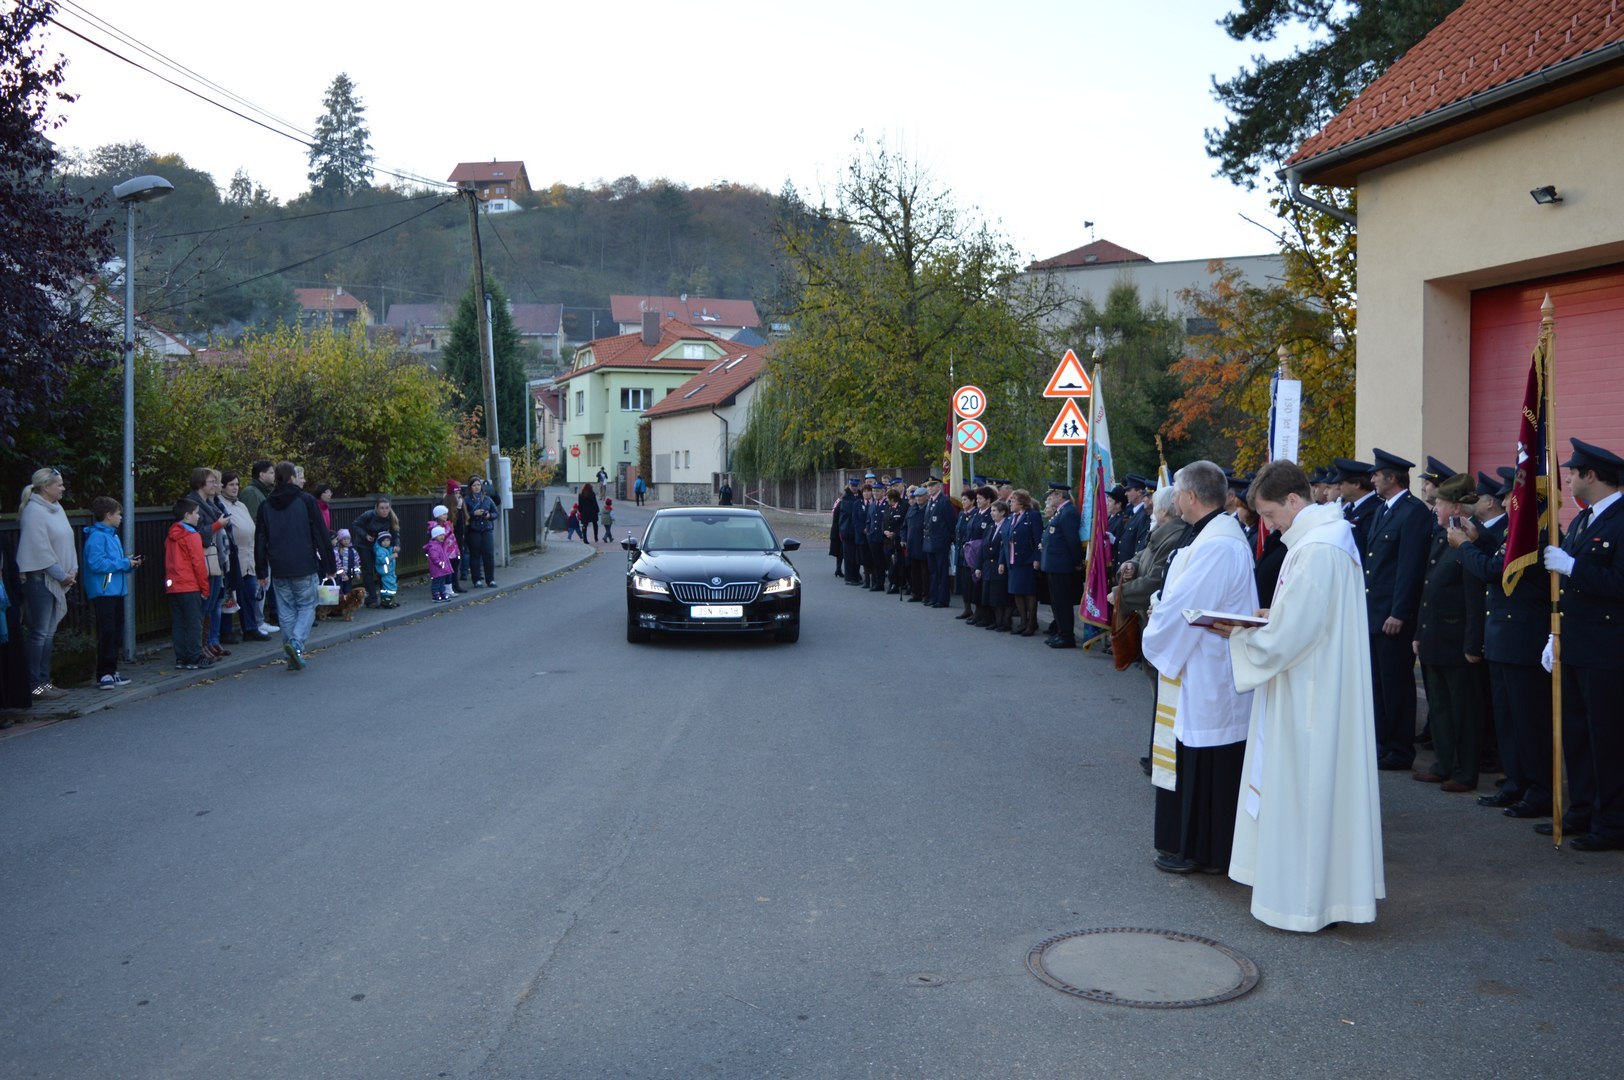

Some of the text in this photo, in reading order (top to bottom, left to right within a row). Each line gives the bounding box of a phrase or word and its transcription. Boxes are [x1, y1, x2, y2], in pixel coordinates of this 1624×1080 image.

[961, 395, 978, 410] 20
[1284, 398, 1292, 414] 130
[1283, 418, 1291, 429] let
